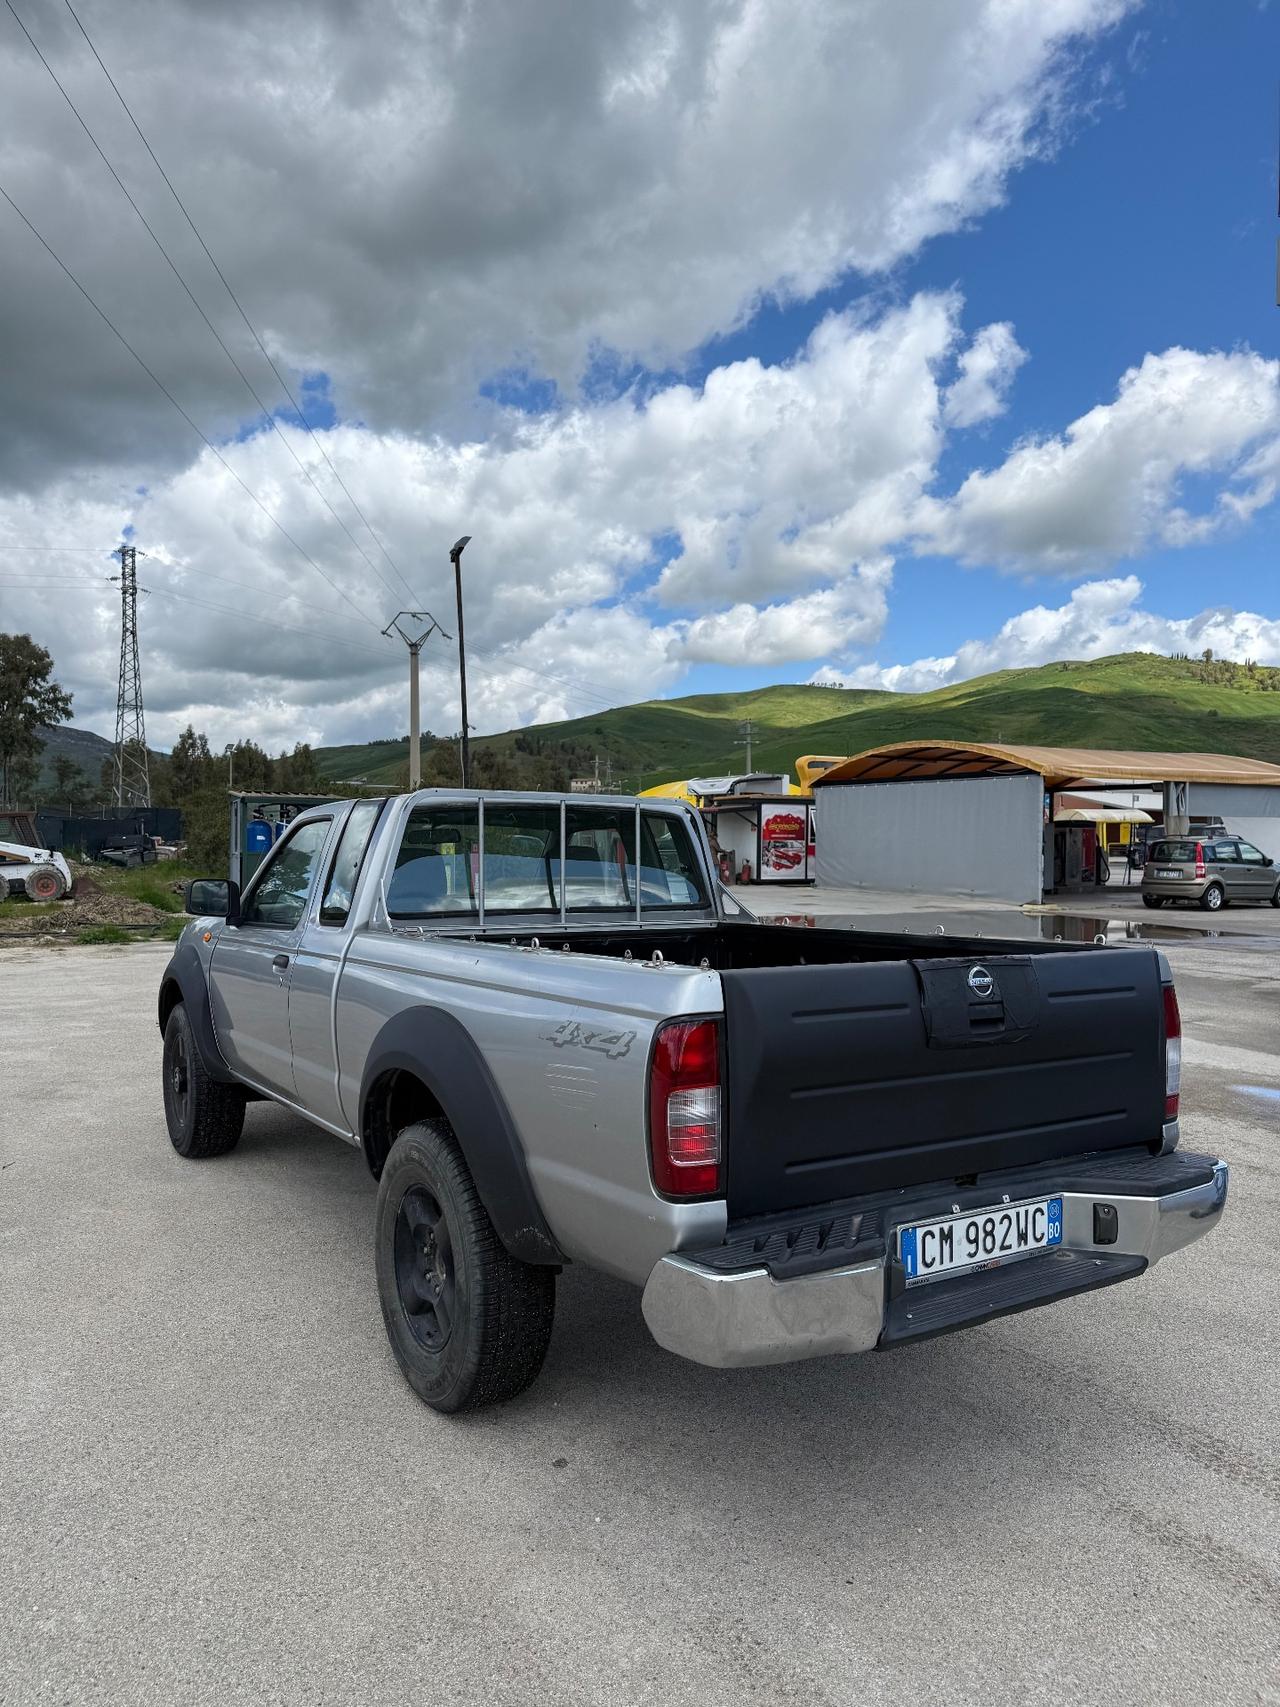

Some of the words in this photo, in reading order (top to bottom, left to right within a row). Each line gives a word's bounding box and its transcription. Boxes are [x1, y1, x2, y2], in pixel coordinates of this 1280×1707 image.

[921, 1224, 954, 1269] CM
[965, 1206, 1045, 1259] 982WC
[1048, 1221, 1060, 1239] BO
